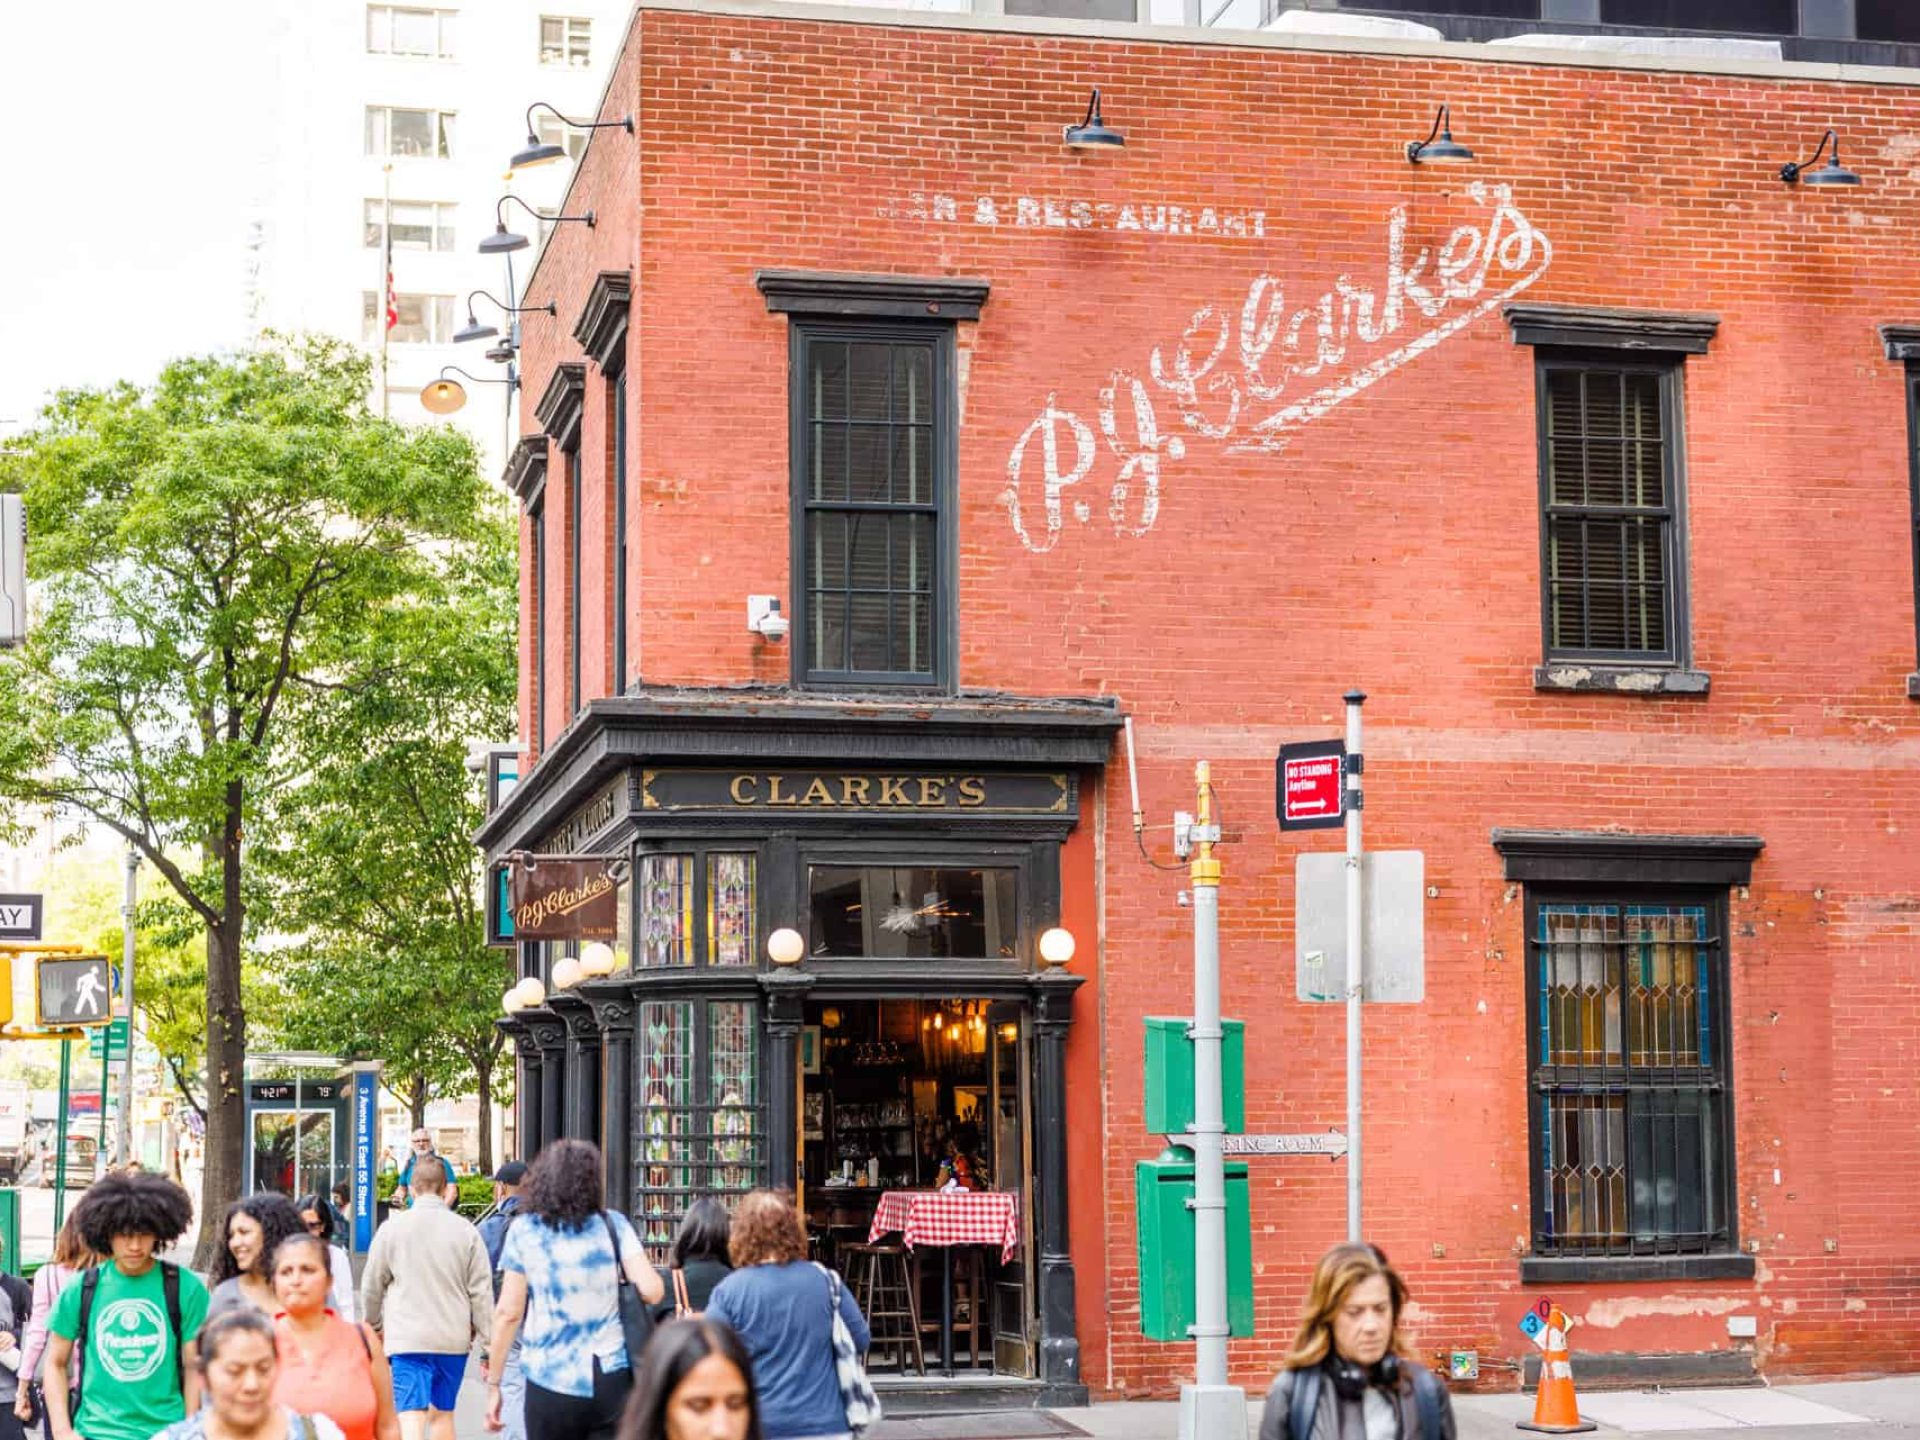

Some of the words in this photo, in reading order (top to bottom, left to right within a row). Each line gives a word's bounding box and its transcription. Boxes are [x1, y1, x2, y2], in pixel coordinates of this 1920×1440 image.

[976, 197, 999, 225] &
[1288, 766, 1299, 778] NO
[1299, 763, 1333, 777] STANDING
[729, 774, 987, 807] CLARKE'S
[1288, 779, 1317, 793] Anytime
[359, 1086, 369, 1095] 3
[358, 1095, 369, 1134] Avenue
[358, 1135, 369, 1144] &
[358, 1145, 369, 1169] East
[358, 1170, 368, 1183] 55
[357, 1185, 368, 1217] Street
[1526, 1315, 1538, 1333] 3
